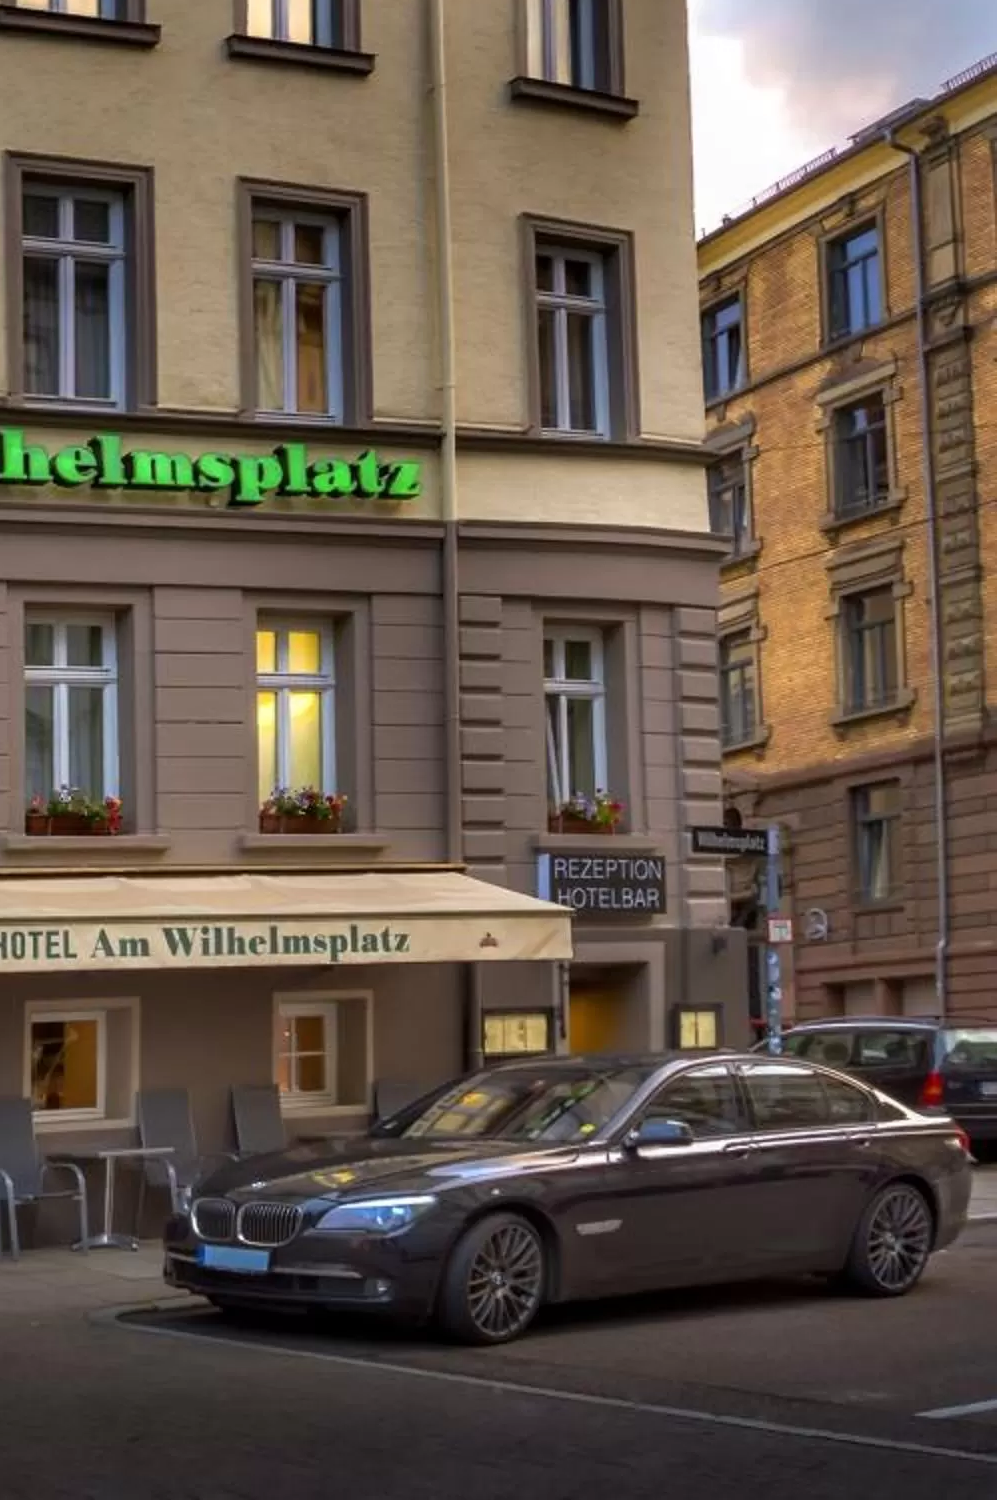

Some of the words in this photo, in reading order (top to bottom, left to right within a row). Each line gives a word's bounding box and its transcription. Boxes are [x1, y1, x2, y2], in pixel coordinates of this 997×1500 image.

[554, 857, 662, 879] REZEPTION
[558, 886, 660, 909] HOTELBAR
[91, 927, 150, 959] Am
[162, 923, 411, 963] Wilhelmsplatz
